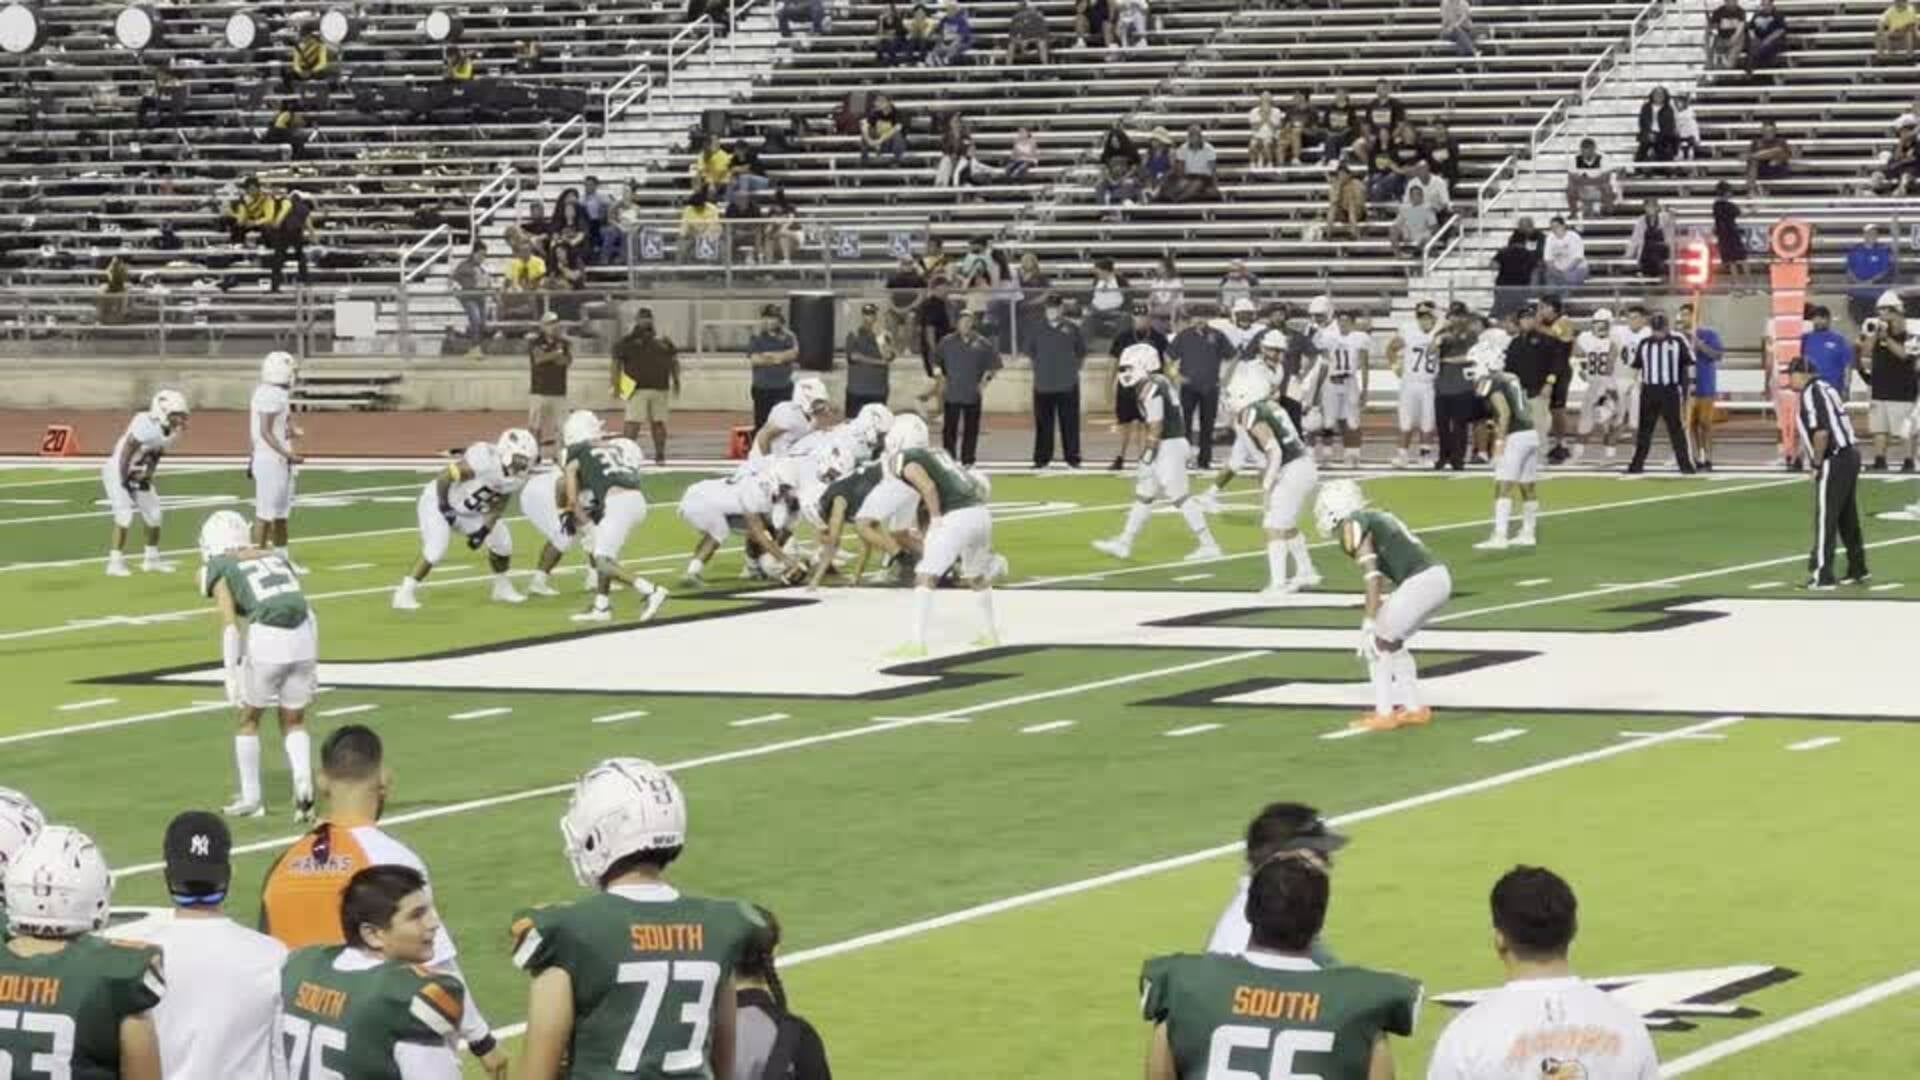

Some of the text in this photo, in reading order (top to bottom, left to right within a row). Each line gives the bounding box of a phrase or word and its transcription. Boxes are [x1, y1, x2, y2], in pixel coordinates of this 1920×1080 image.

[1686, 242, 1709, 283] 3
[1336, 348, 1349, 370] 11
[43, 429, 67, 452] 20
[240, 557, 301, 600] 25
[190, 834, 209, 856] NY
[631, 924, 704, 951] SOUTH
[295, 982, 347, 1020] SOUTH
[616, 960, 721, 1073] 73
[1232, 986, 1321, 1021] SOUTH
